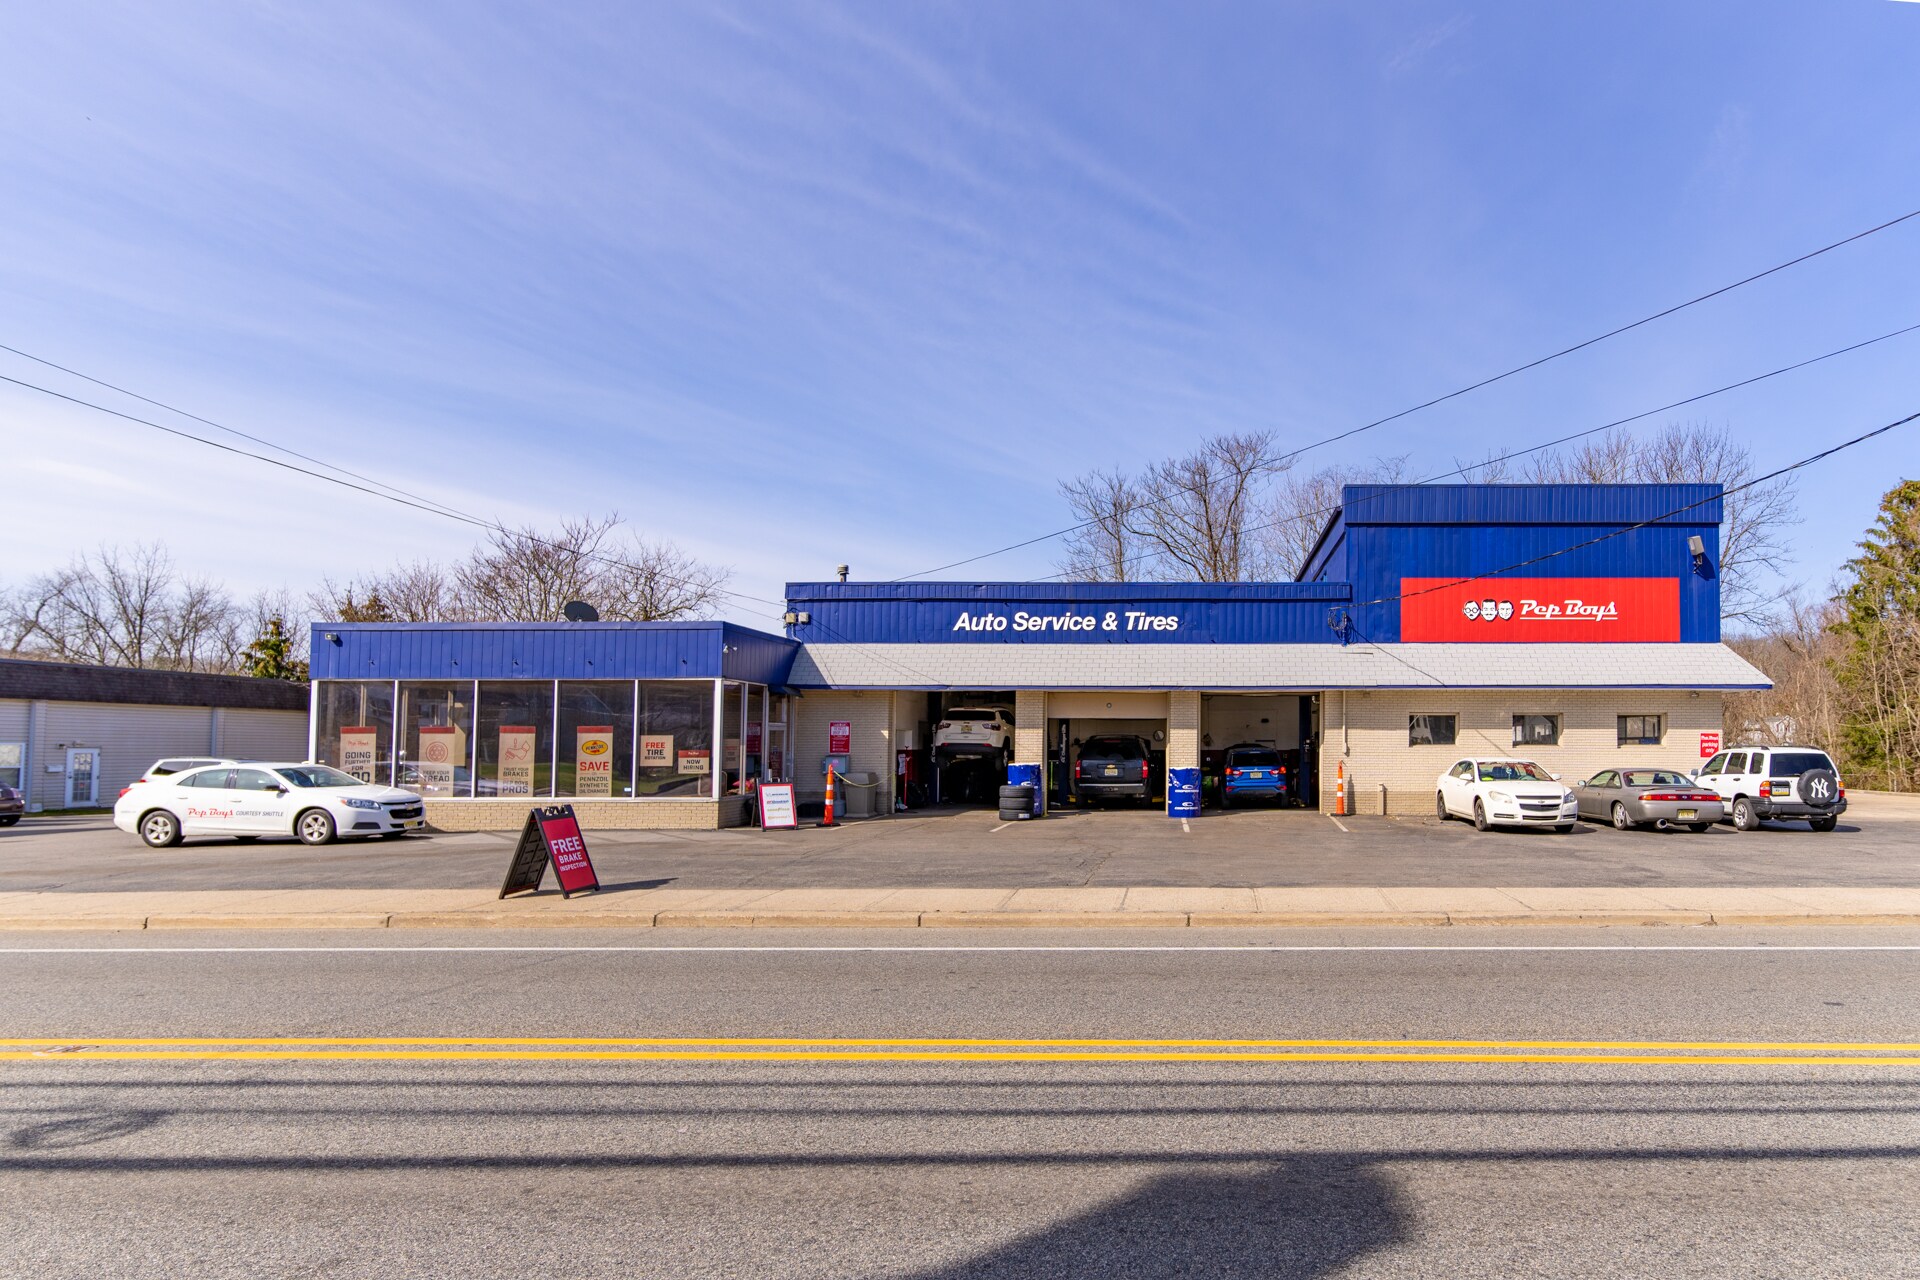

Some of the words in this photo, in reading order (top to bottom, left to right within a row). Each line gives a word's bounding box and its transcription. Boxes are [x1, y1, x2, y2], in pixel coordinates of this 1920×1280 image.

[1519, 599, 1562, 618] Pep
[1564, 599, 1618, 622] Boys
[953, 612, 1008, 631] Auto
[1012, 611, 1097, 632] Service
[1101, 611, 1119, 632] &
[1124, 612, 1179, 632] Tires
[345, 751, 371, 759] GOING
[579, 761, 610, 771] SAVE
[502, 785, 529, 794] PROS
[188, 807, 207, 817] Pep
[208, 807, 233, 819] Boys
[550, 836, 582, 855] FREE
[558, 852, 583, 864] BRAKE
[560, 861, 587, 872] INSPECTION
